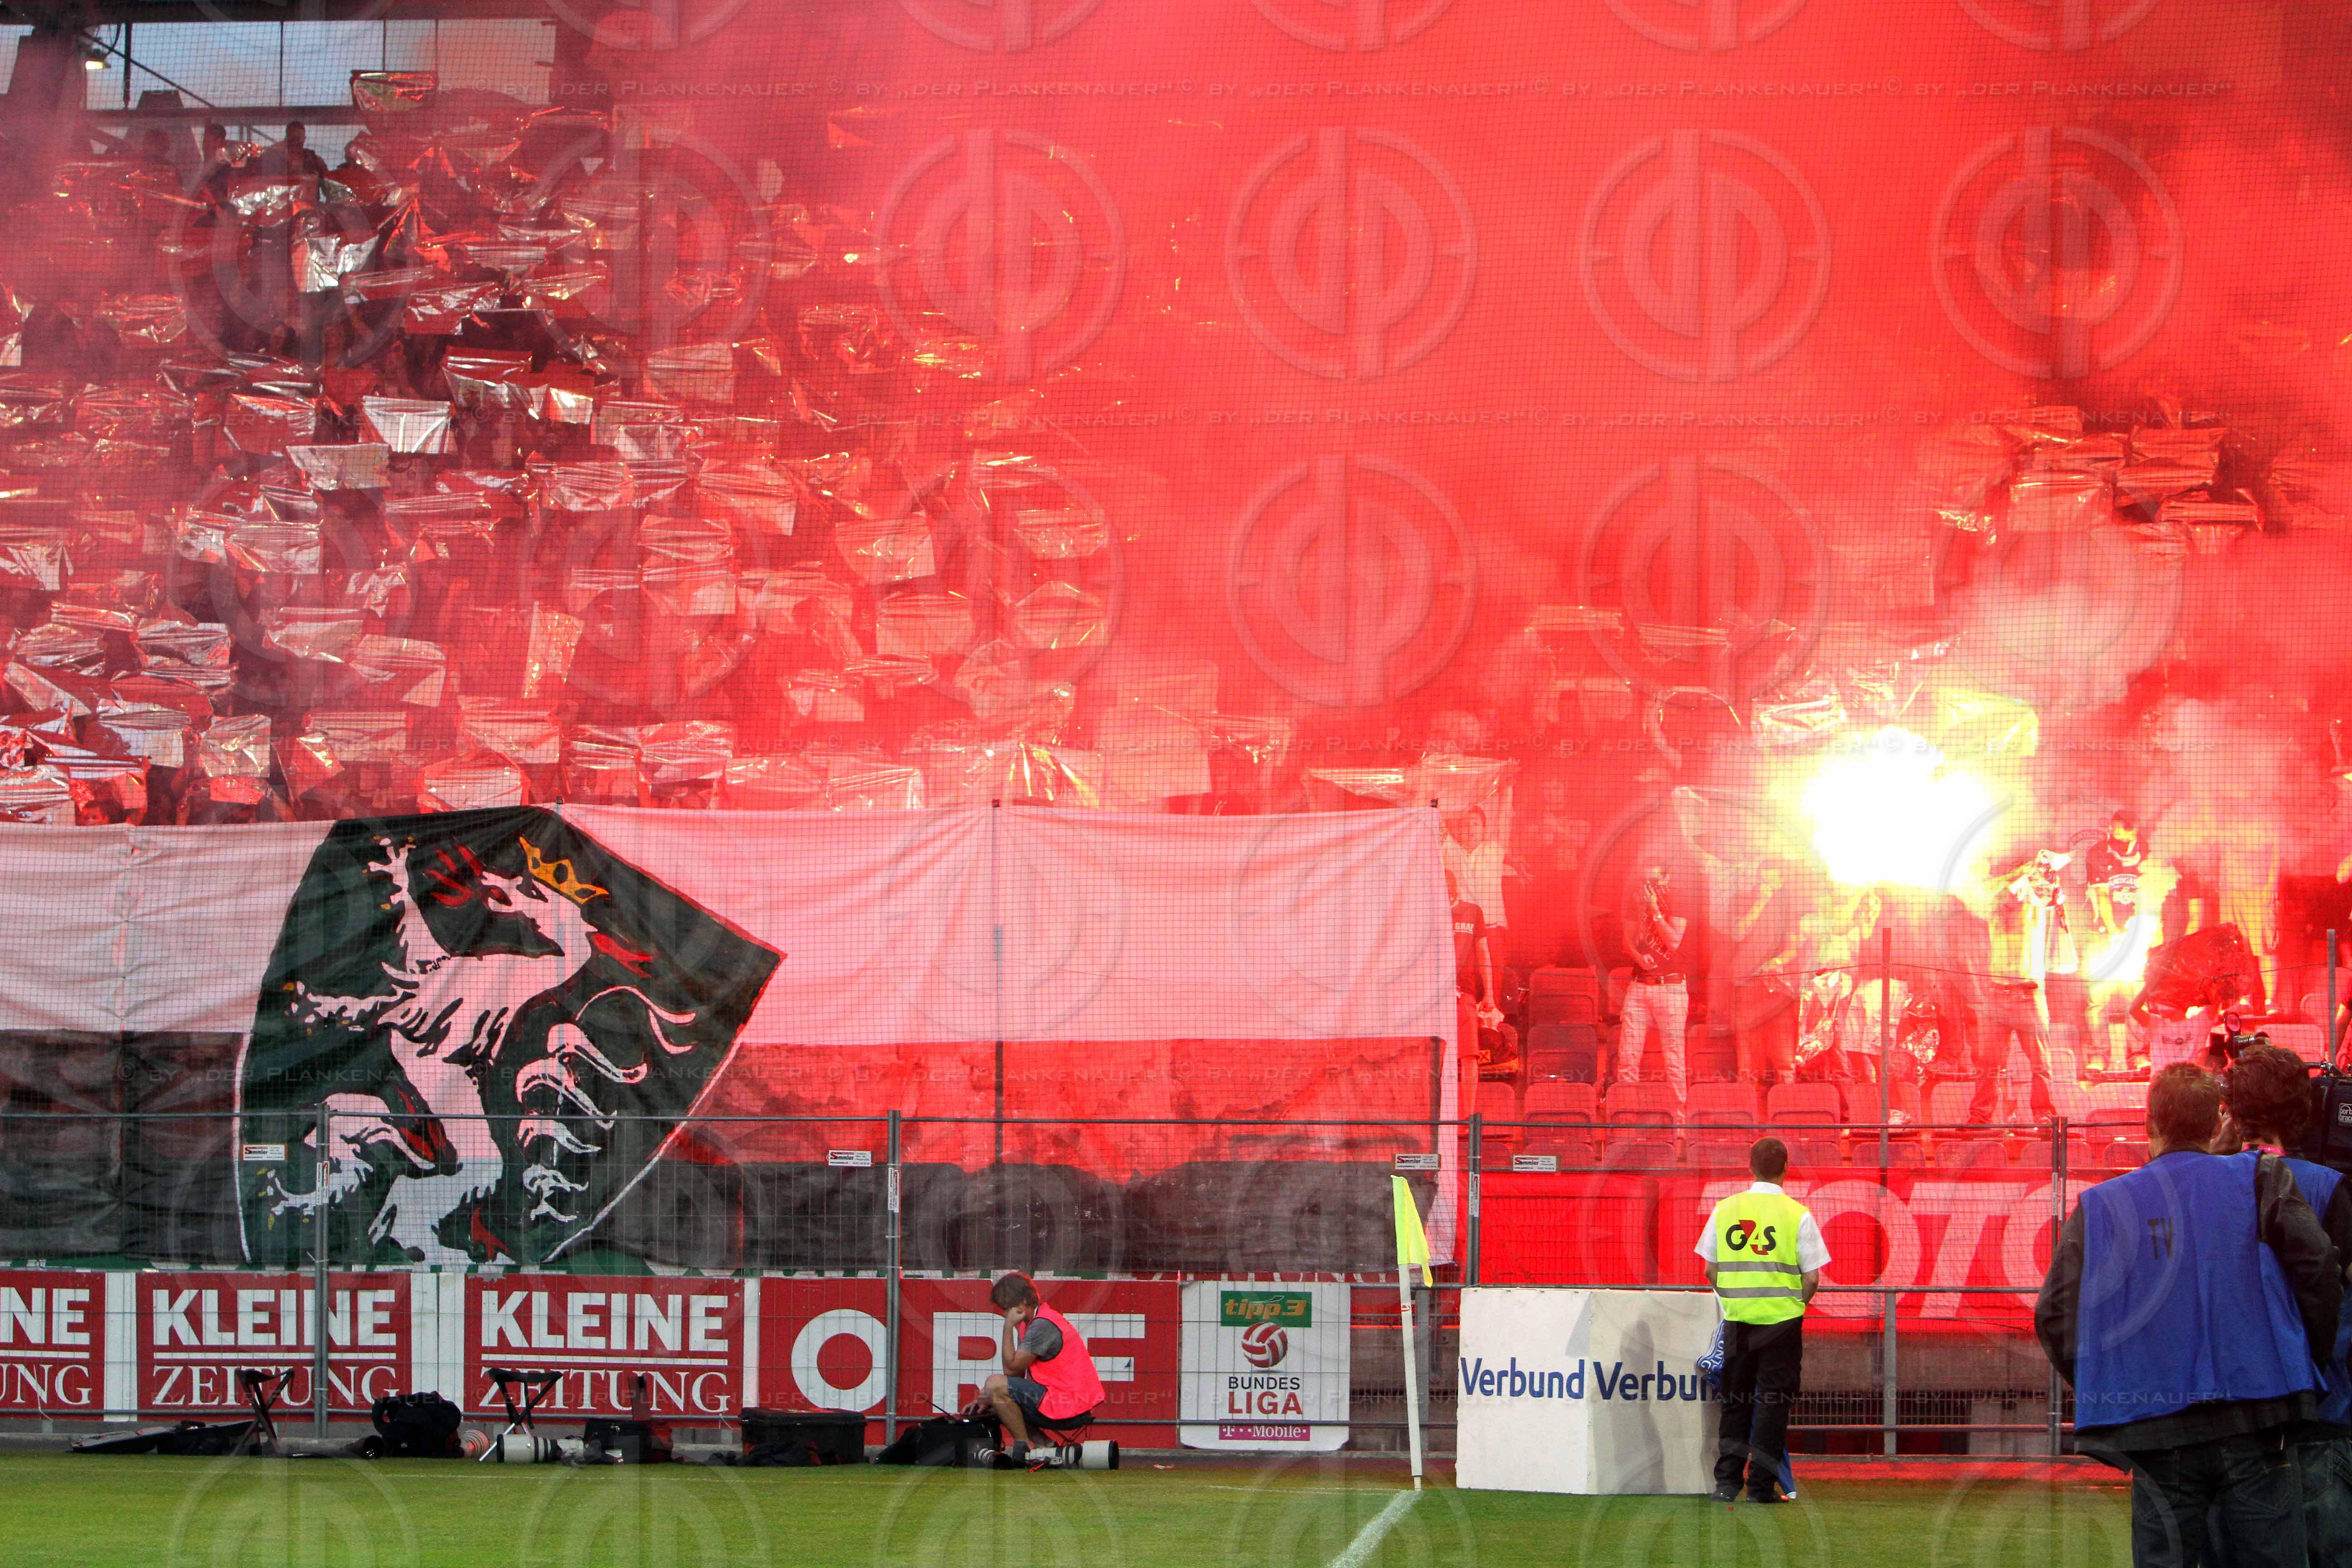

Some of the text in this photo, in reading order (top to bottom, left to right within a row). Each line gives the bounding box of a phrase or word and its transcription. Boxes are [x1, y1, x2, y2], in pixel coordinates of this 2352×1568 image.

[1725, 1220, 1776, 1255] G4S
[2147, 1216, 2176, 1260] TV
[153, 1289, 397, 1346] KLEINE
[481, 1290, 728, 1352] KLEINE
[0, 1364, 92, 1405] NG
[1228, 1377, 1300, 1390] BUNDES
[1460, 1357, 1585, 1400] Verbund
[1593, 1360, 1709, 1401] Verbu
[1228, 1391, 1303, 1415] LIGA
